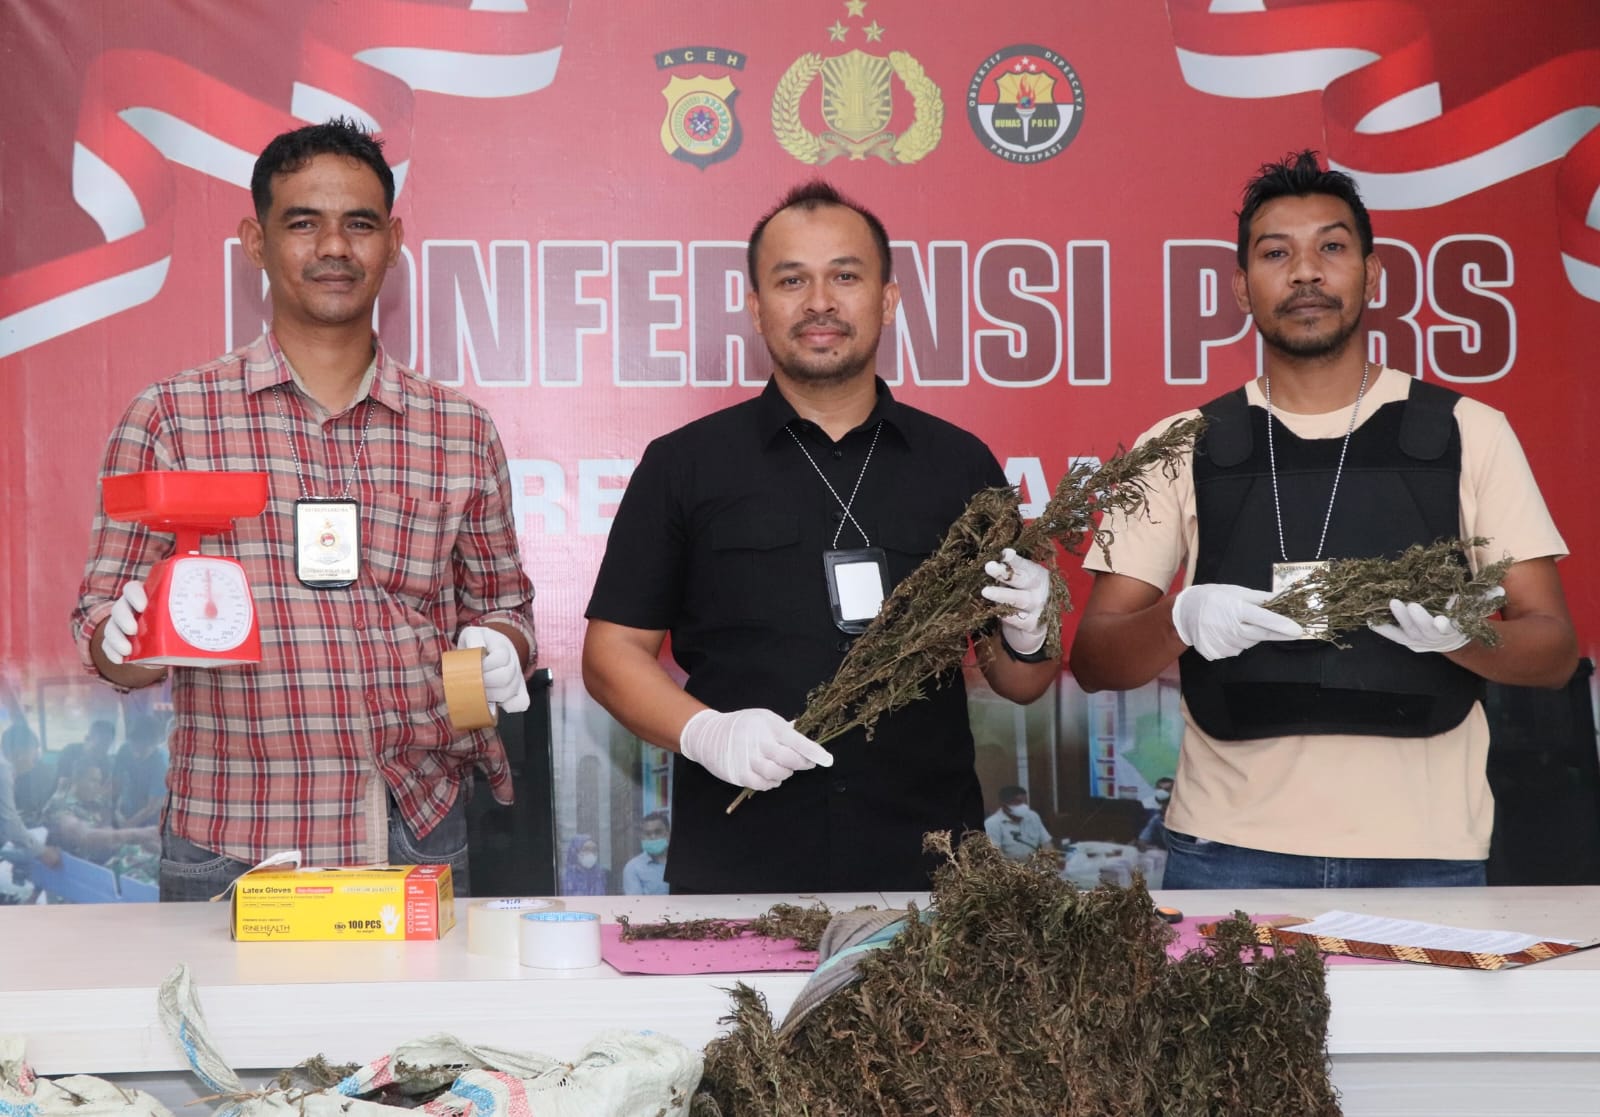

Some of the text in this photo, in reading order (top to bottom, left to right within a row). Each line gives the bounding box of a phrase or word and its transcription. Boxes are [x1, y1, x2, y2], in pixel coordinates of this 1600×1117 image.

[664, 51, 738, 66] ACEH
[968, 53, 1001, 107] OBYEKTIF
[994, 119, 1058, 128] HUMAS POLRI
[990, 143, 1063, 162] PARTISIPASI
[1163, 233, 1518, 385] PRS
[348, 920, 382, 929] 100 PCS
